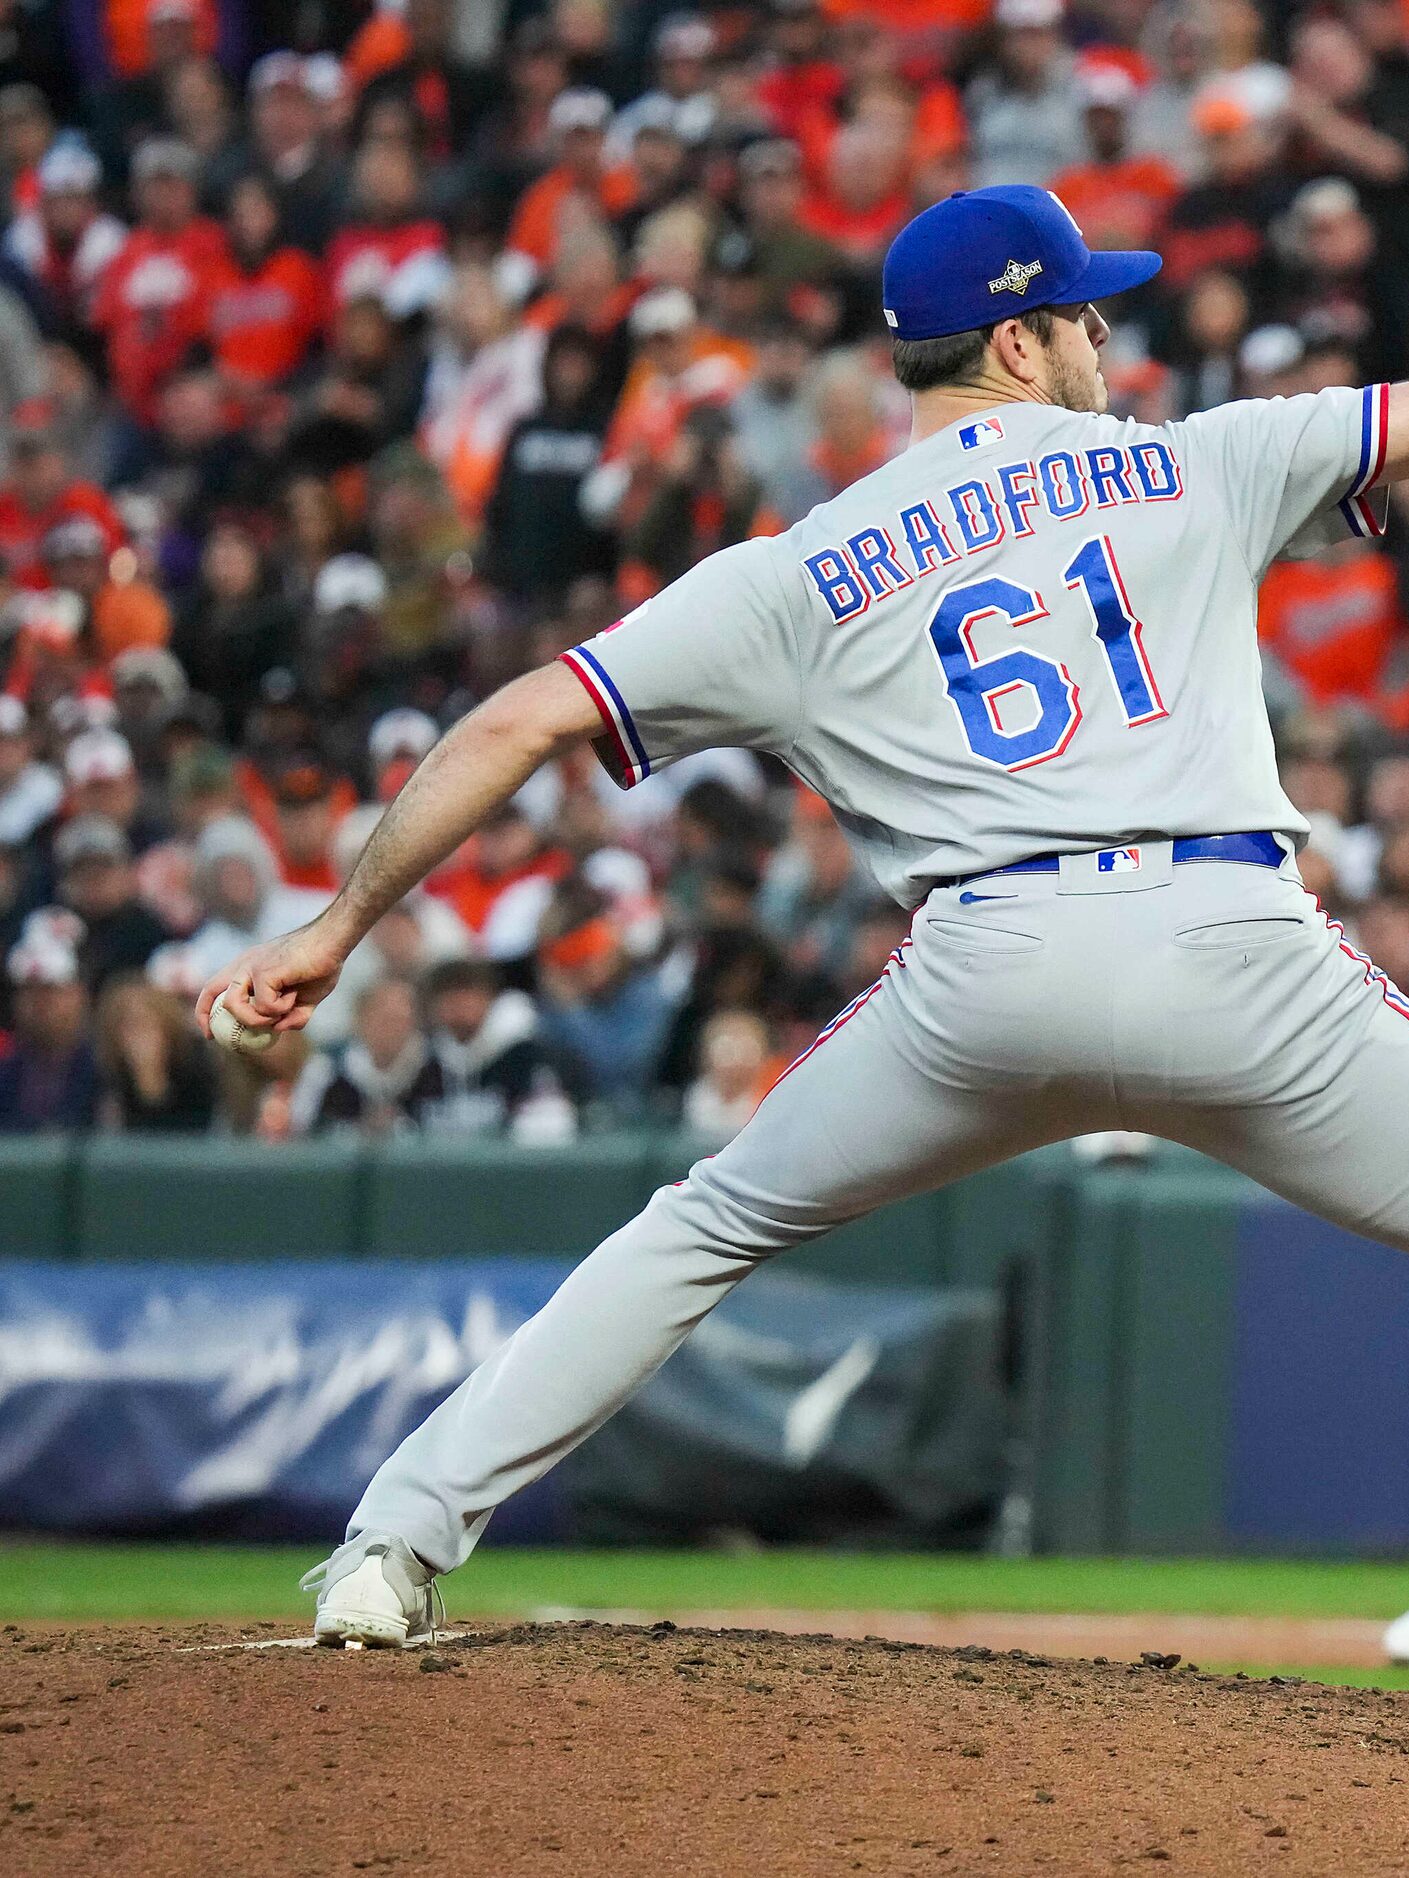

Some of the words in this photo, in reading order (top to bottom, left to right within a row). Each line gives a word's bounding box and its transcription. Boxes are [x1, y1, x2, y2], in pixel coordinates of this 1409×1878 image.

[988, 260, 1042, 294] POSTSEASON
[800, 441, 1184, 626] BRADFORD
[926, 533, 1170, 773] 61
